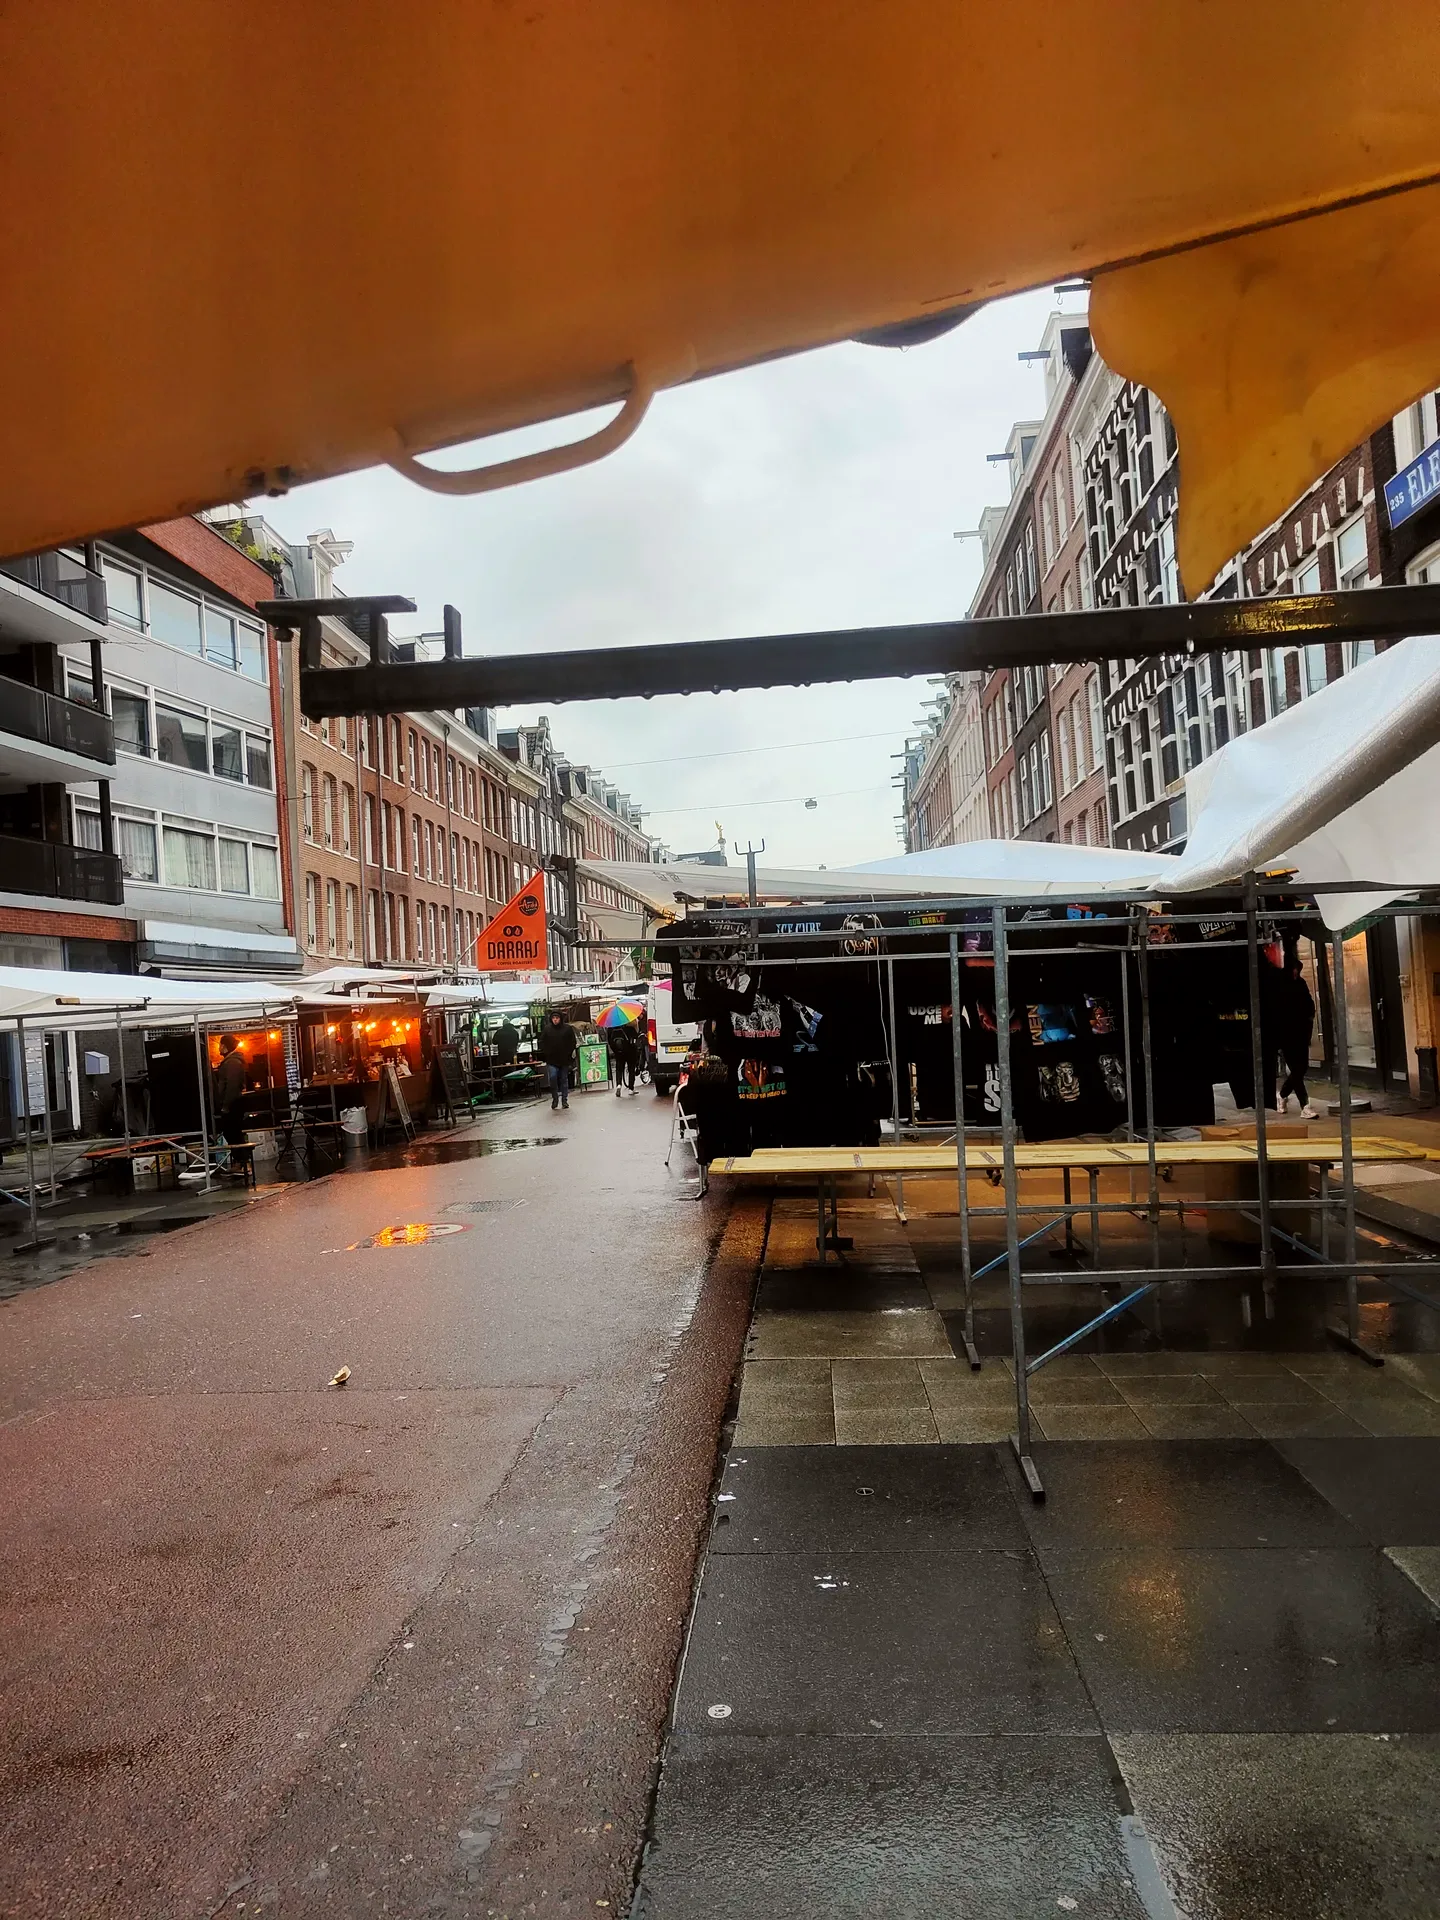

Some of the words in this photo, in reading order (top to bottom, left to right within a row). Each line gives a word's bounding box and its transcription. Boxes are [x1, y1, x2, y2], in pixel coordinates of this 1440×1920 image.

[1389, 491, 1405, 512] 235
[487, 940, 540, 960] DARRAS
[923, 1014, 943, 1025] ME
